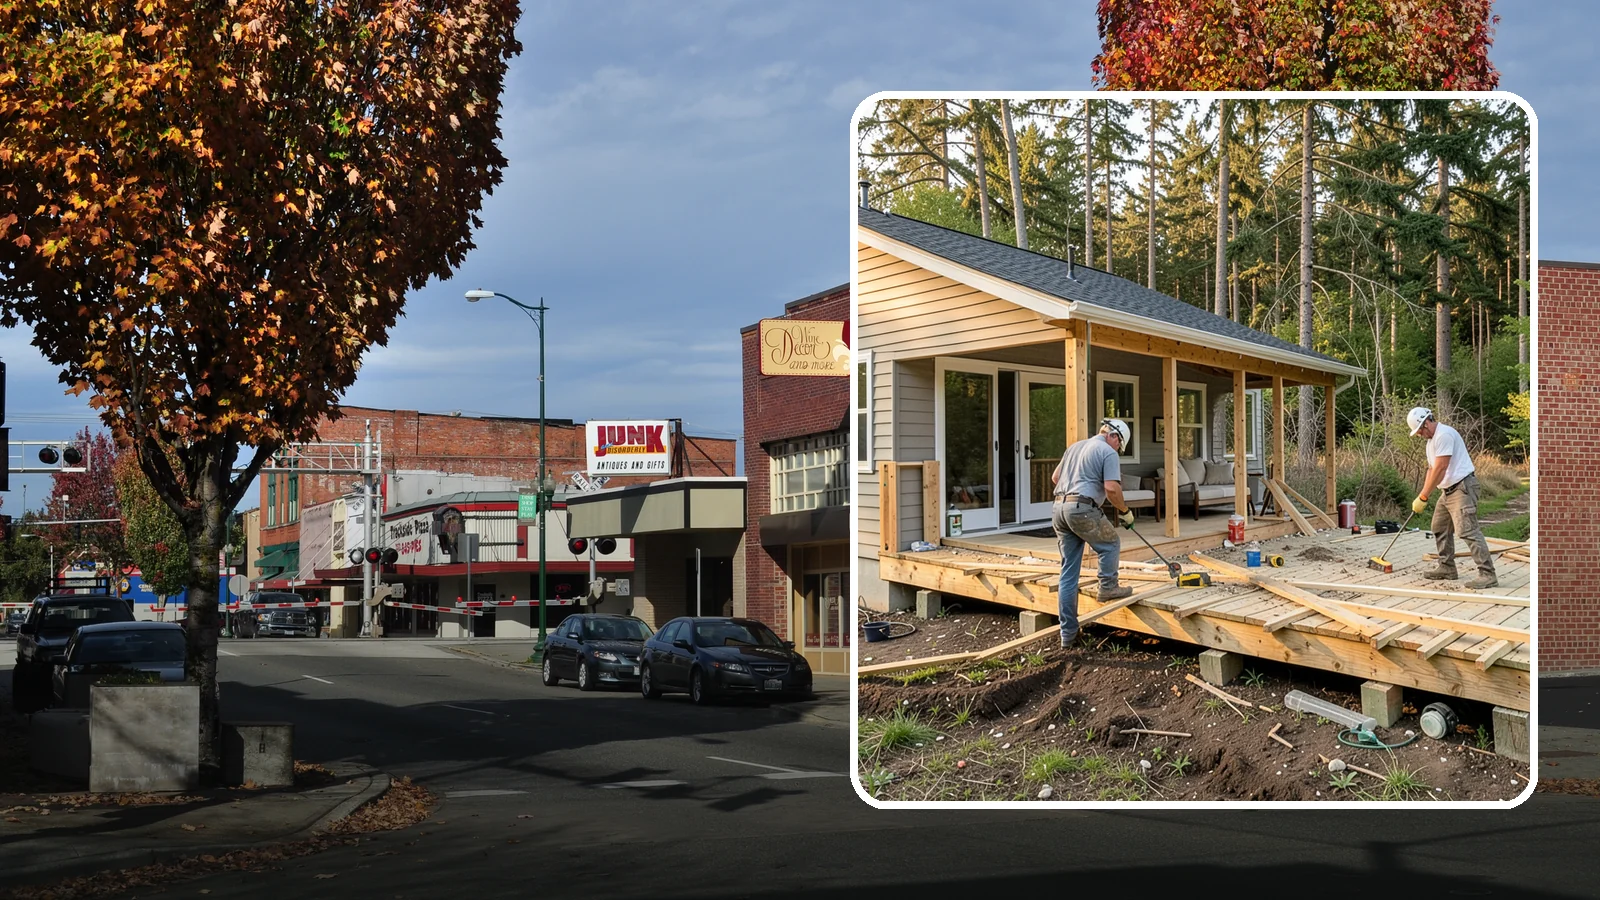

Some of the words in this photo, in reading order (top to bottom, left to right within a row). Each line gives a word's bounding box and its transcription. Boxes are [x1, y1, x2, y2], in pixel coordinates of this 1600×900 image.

[596, 426, 665, 457] JUNK
[607, 446, 646, 454] DISORDERLY
[597, 461, 628, 470] ANTIQUES
[631, 461, 644, 470] AND
[647, 461, 665, 469] GIFTS
[414, 519, 429, 535] Pizza
